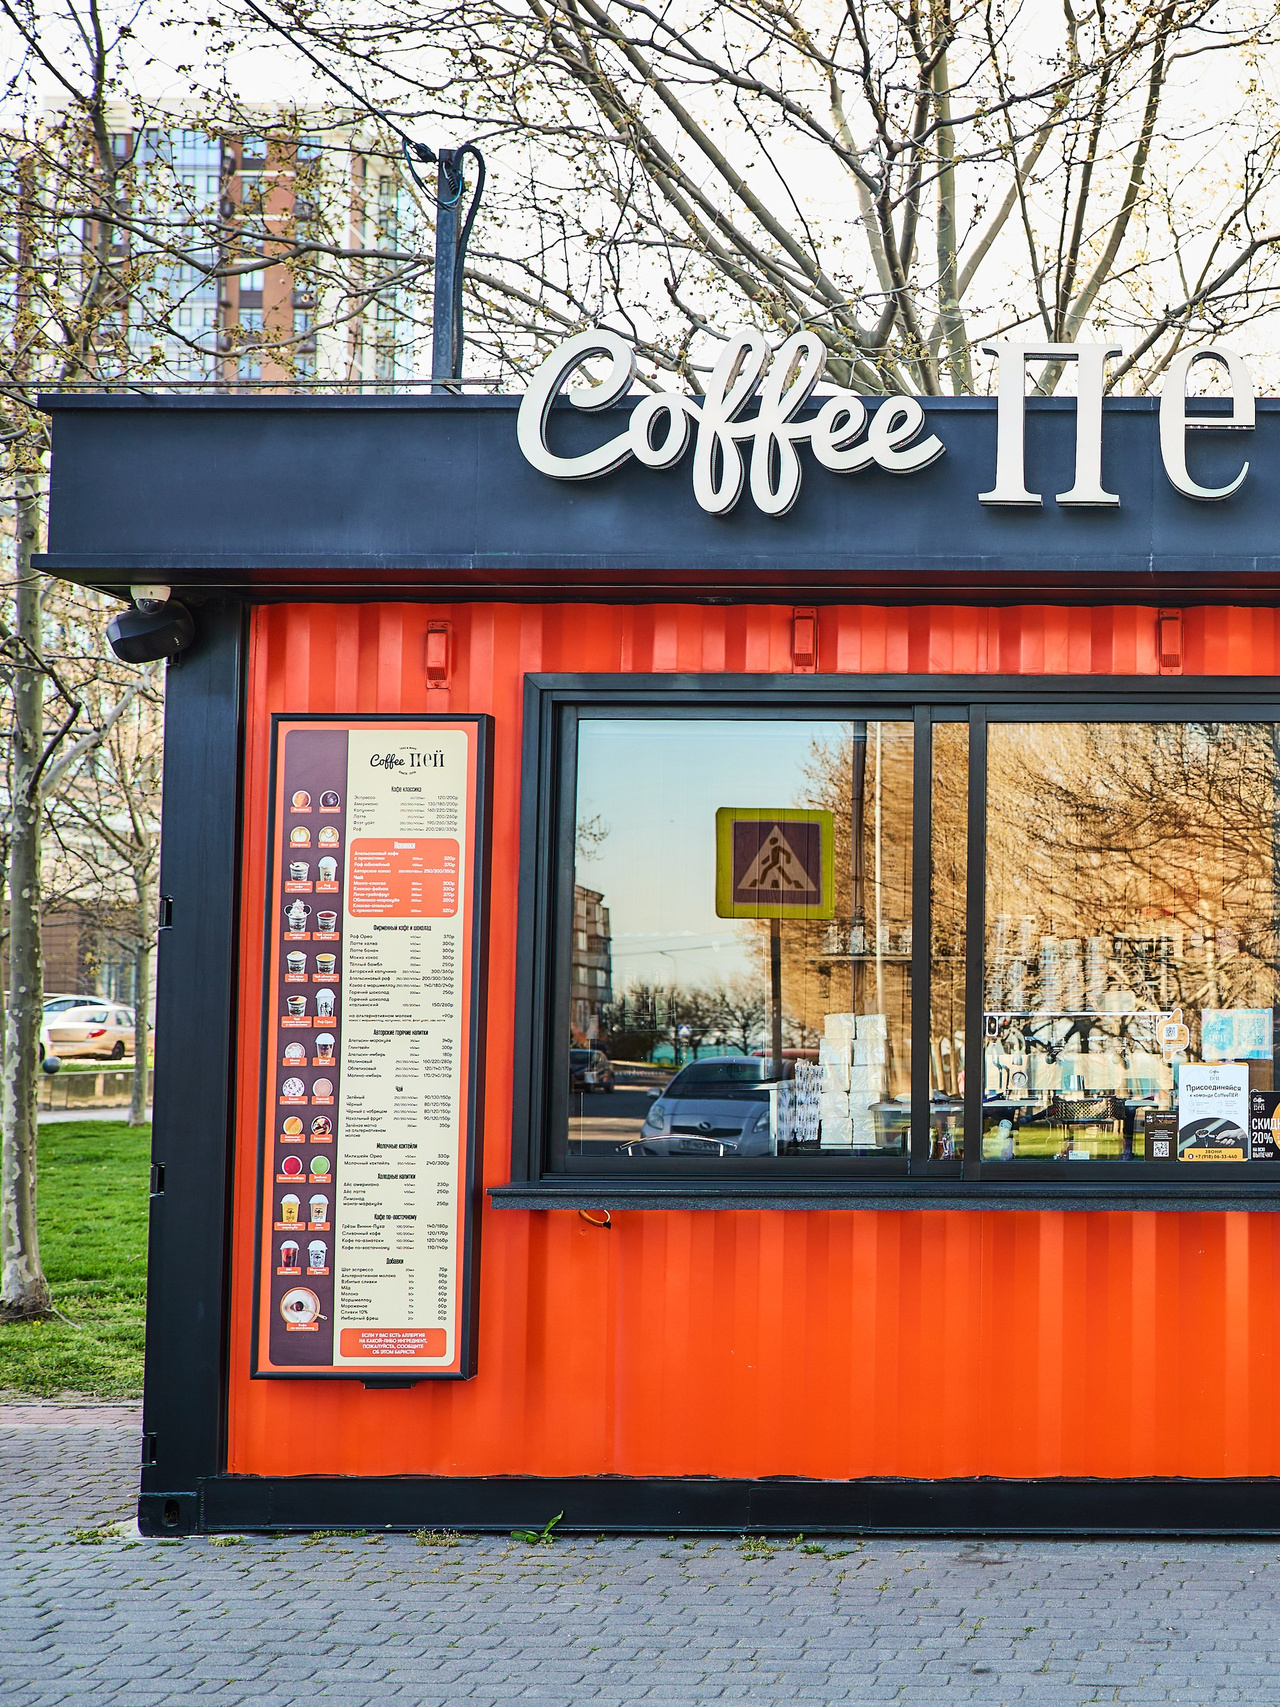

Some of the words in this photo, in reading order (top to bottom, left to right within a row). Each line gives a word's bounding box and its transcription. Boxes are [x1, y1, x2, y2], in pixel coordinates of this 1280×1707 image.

[516, 329, 947, 517] Coffee
[370, 753, 405, 770] Coffee
[1186, 1084, 1242, 1092] Присоединяйся
[1252, 1132, 1273, 1144] 20%
